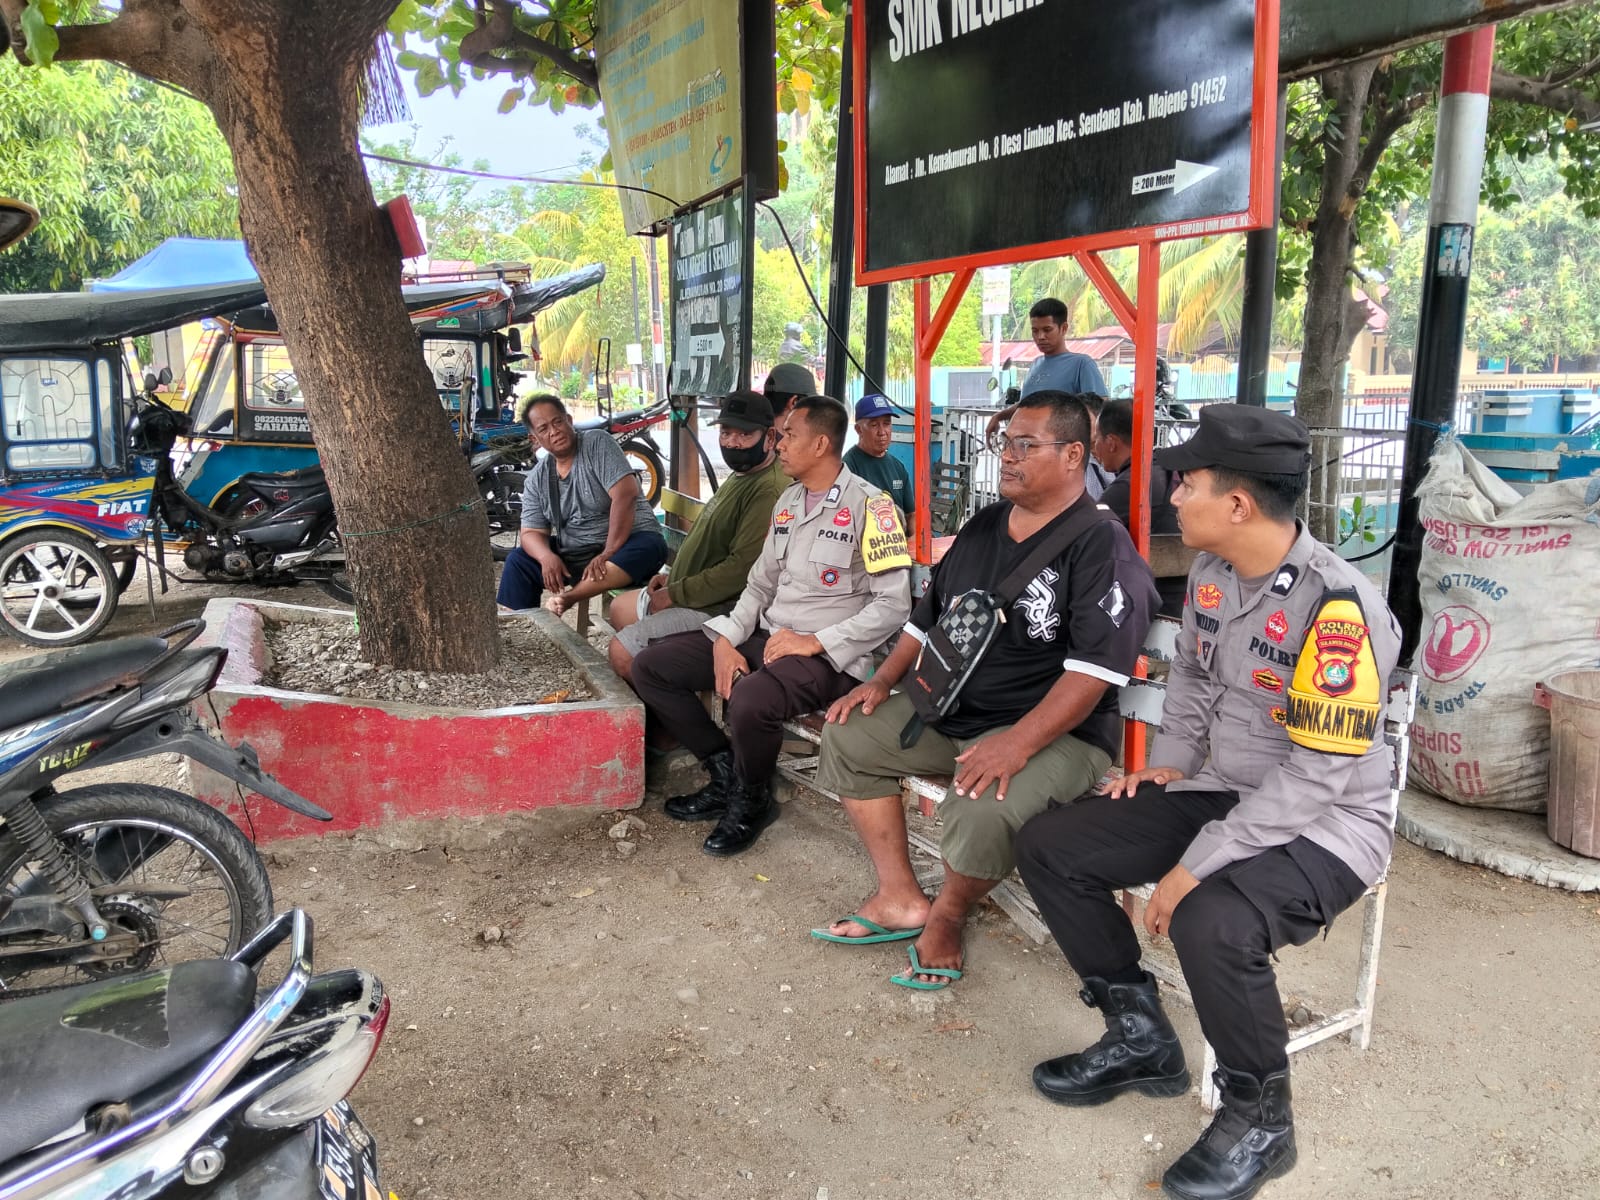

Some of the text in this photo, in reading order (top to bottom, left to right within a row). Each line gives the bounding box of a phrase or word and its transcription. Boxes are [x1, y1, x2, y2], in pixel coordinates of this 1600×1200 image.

[888, 0, 943, 62] SMK
[885, 161, 909, 185] Alamat
[914, 157, 927, 178] Jln.
[928, 145, 977, 174] Kemakmuran
[978, 140, 991, 162] No.
[993, 136, 1000, 159] 8
[1001, 131, 1022, 157] Desa
[1023, 124, 1054, 151] Limbua
[1056, 119, 1076, 142] Kec.
[1079, 107, 1120, 137] Sendana
[1123, 98, 1145, 126] Kab.
[1148, 88, 1187, 119] Majene
[1190, 75, 1227, 108] 91452
[1141, 176, 1153, 190] 200
[1155, 173, 1175, 187] Meter
[97, 499, 147, 517] FIAT
[818, 529, 854, 544] POLRI
[1463, 533, 1572, 559] SWALLOW
[1319, 621, 1365, 636] POLRES
[1249, 636, 1298, 667] POLRI
[1436, 678, 1487, 715] TRADE
